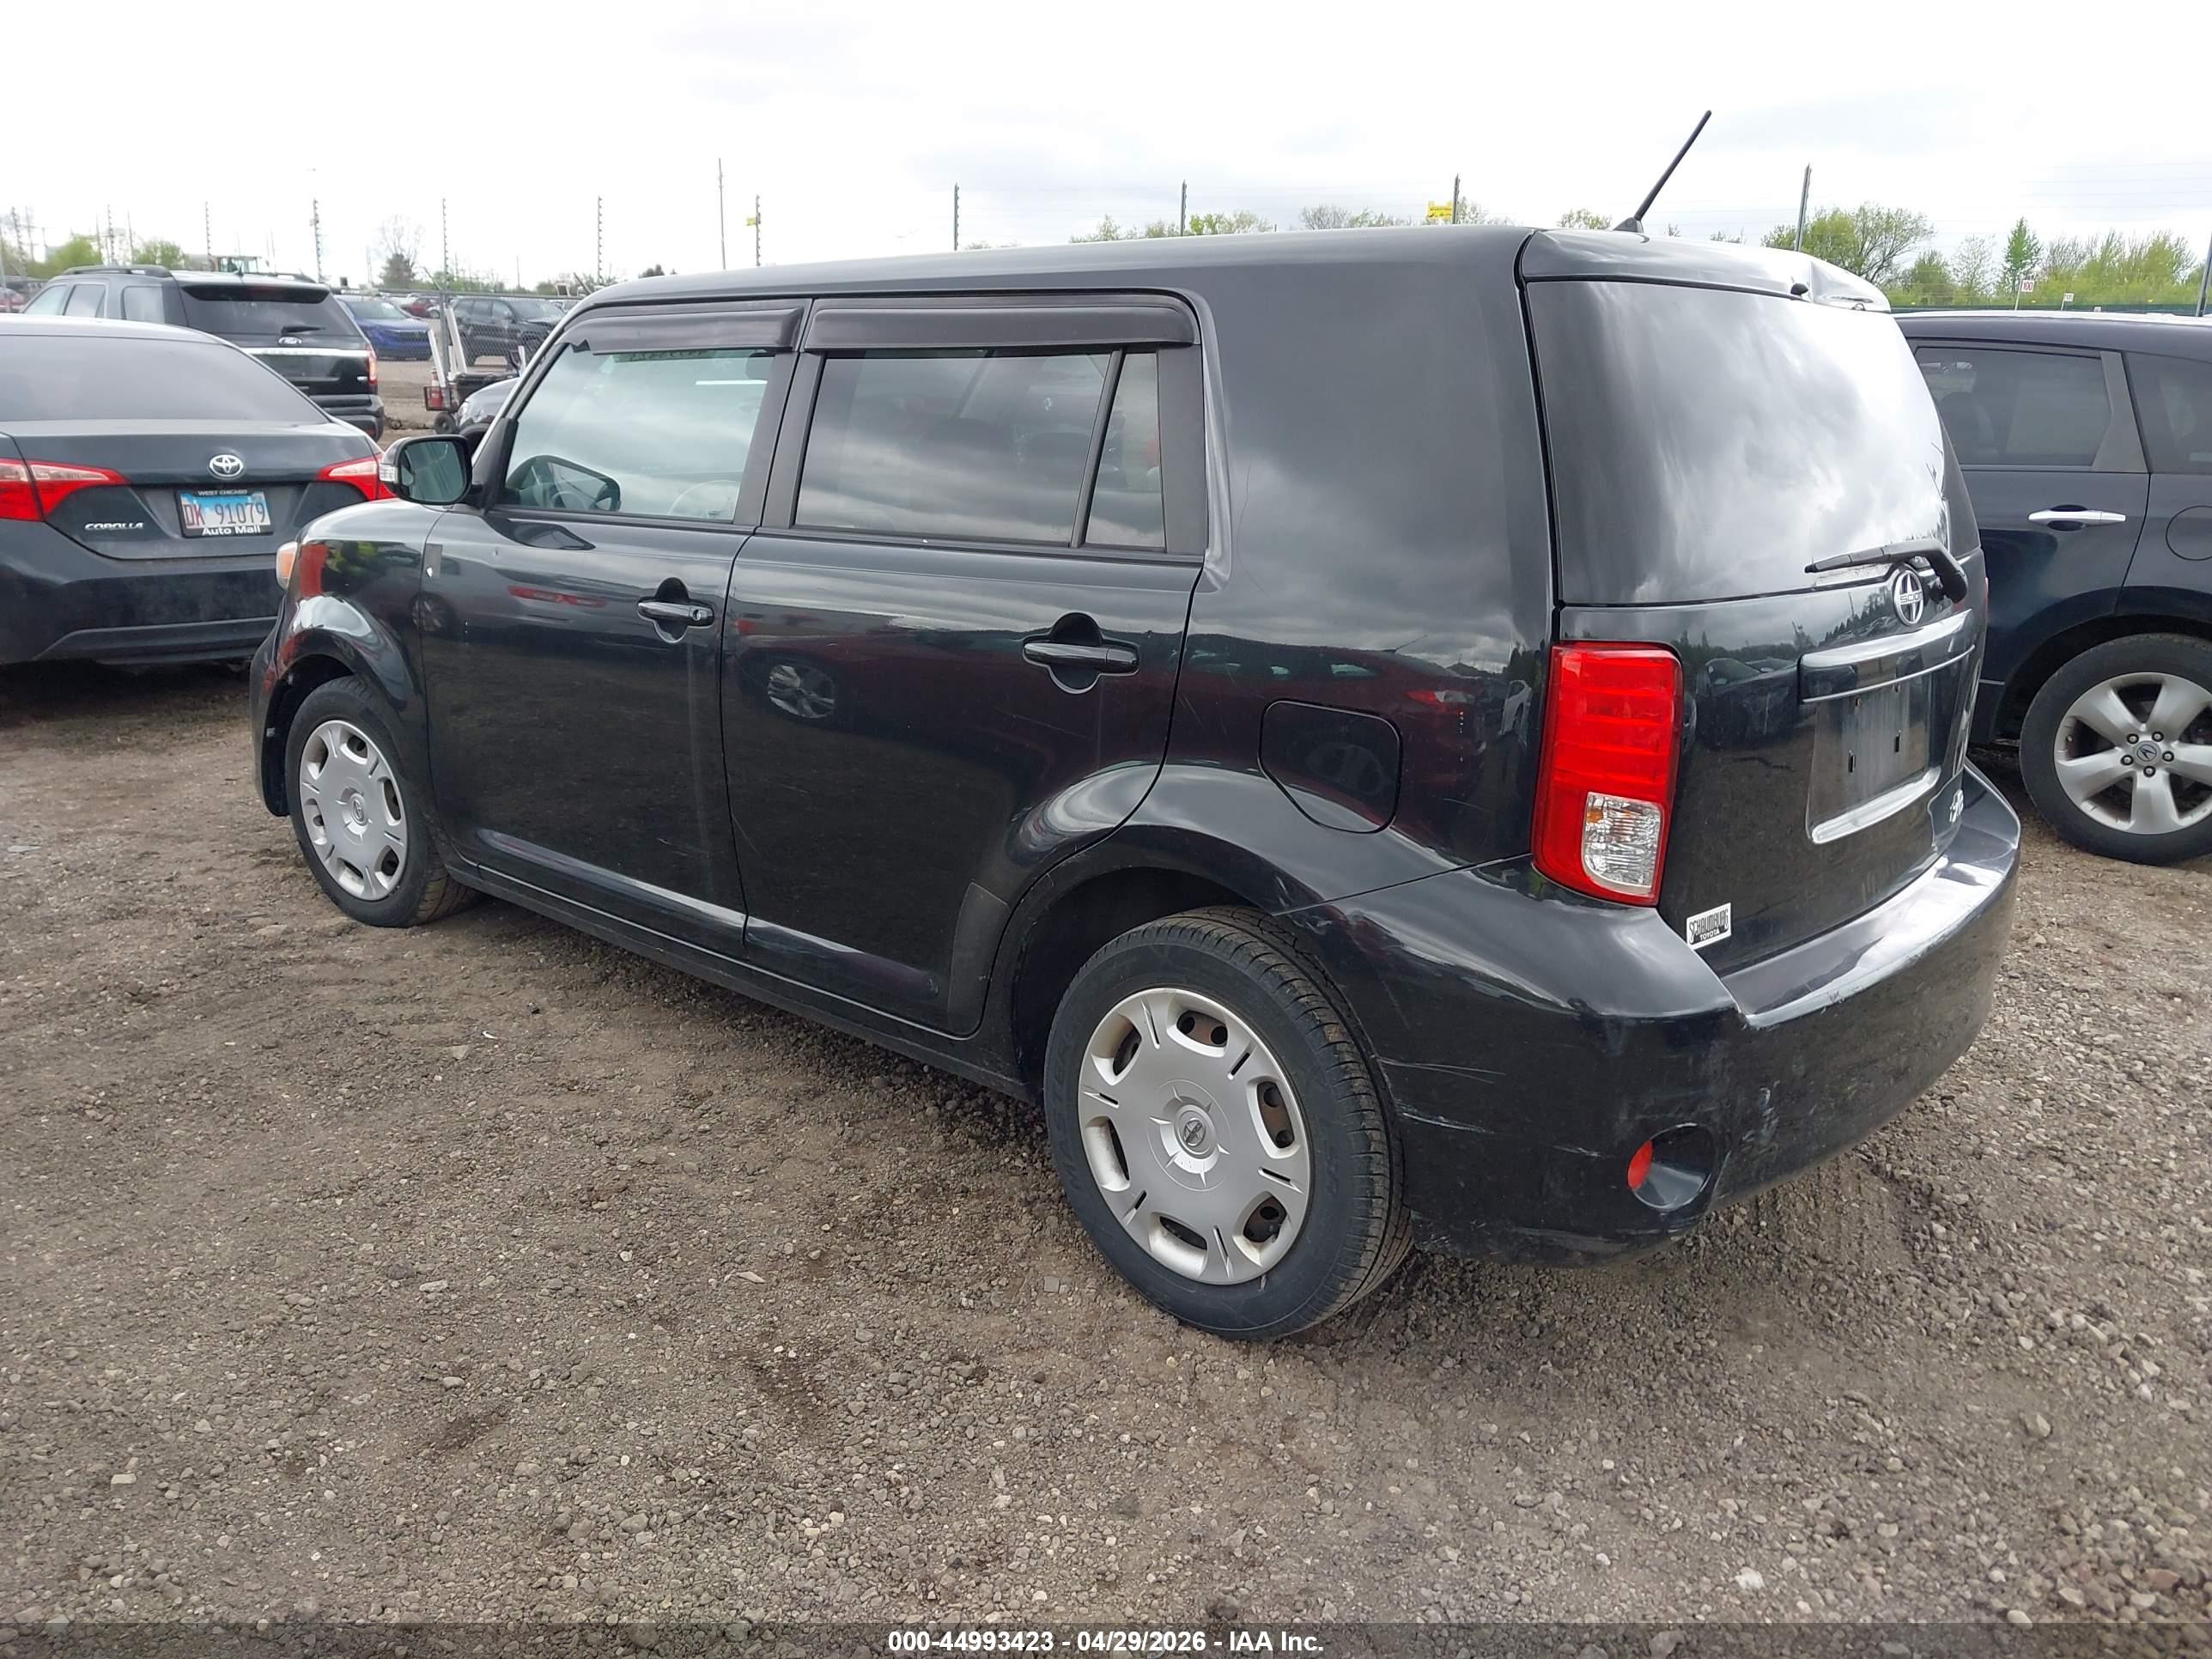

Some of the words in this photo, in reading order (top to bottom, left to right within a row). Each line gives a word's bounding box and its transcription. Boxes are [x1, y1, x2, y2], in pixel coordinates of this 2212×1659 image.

[184, 503, 205, 526] DK
[214, 501, 265, 525] 91079
[84, 522, 143, 531] COROLLA
[202, 526, 232, 535] Auto
[235, 525, 261, 534] Mall
[1699, 927, 1721, 941] TOYOTA
